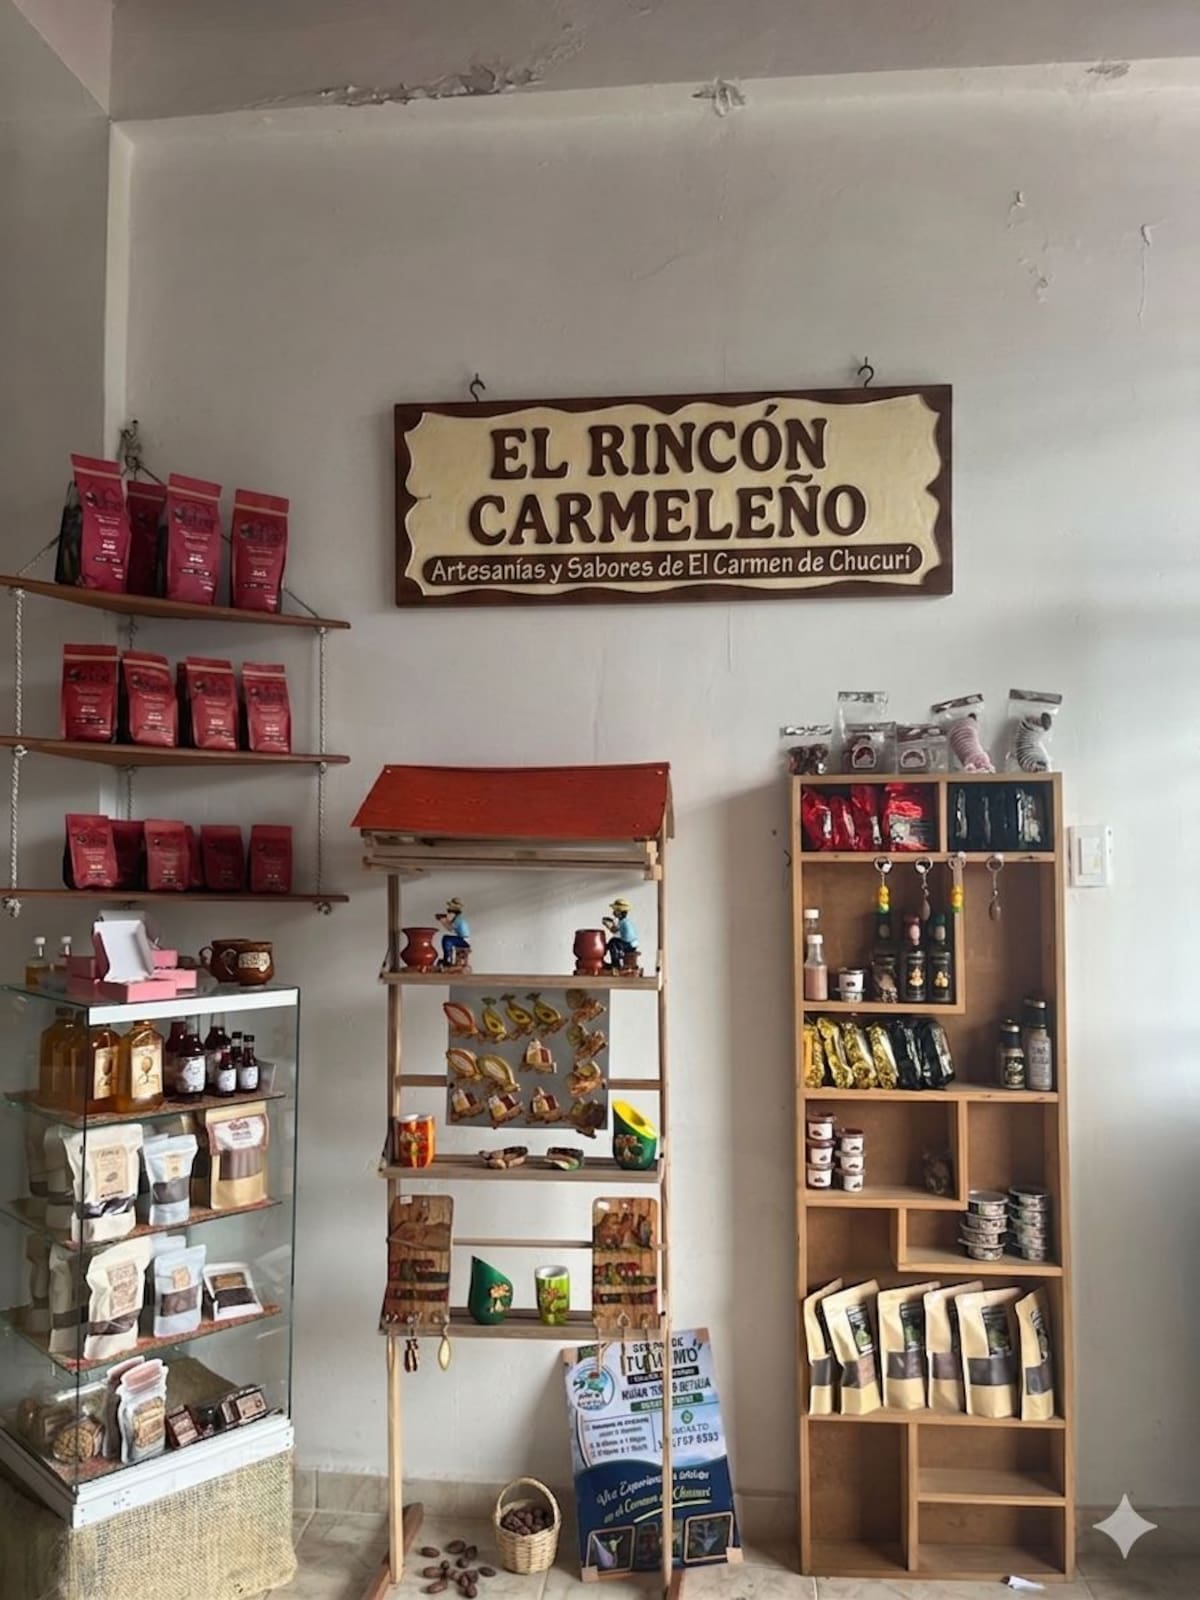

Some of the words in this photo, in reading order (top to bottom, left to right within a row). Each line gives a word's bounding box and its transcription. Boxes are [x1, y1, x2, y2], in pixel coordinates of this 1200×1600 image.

[490, 427, 569, 480] EL
[587, 405, 827, 477] RINCÓN
[468, 474, 867, 546] CARMELEÑO
[431, 558, 545, 582] Artesanías
[549, 563, 562, 585] y
[568, 556, 653, 579] Sabores
[658, 553, 683, 576] de
[688, 553, 708, 576] El
[713, 552, 793, 576] Carmen
[797, 550, 824, 573] de
[829, 546, 912, 571] Chucurí
